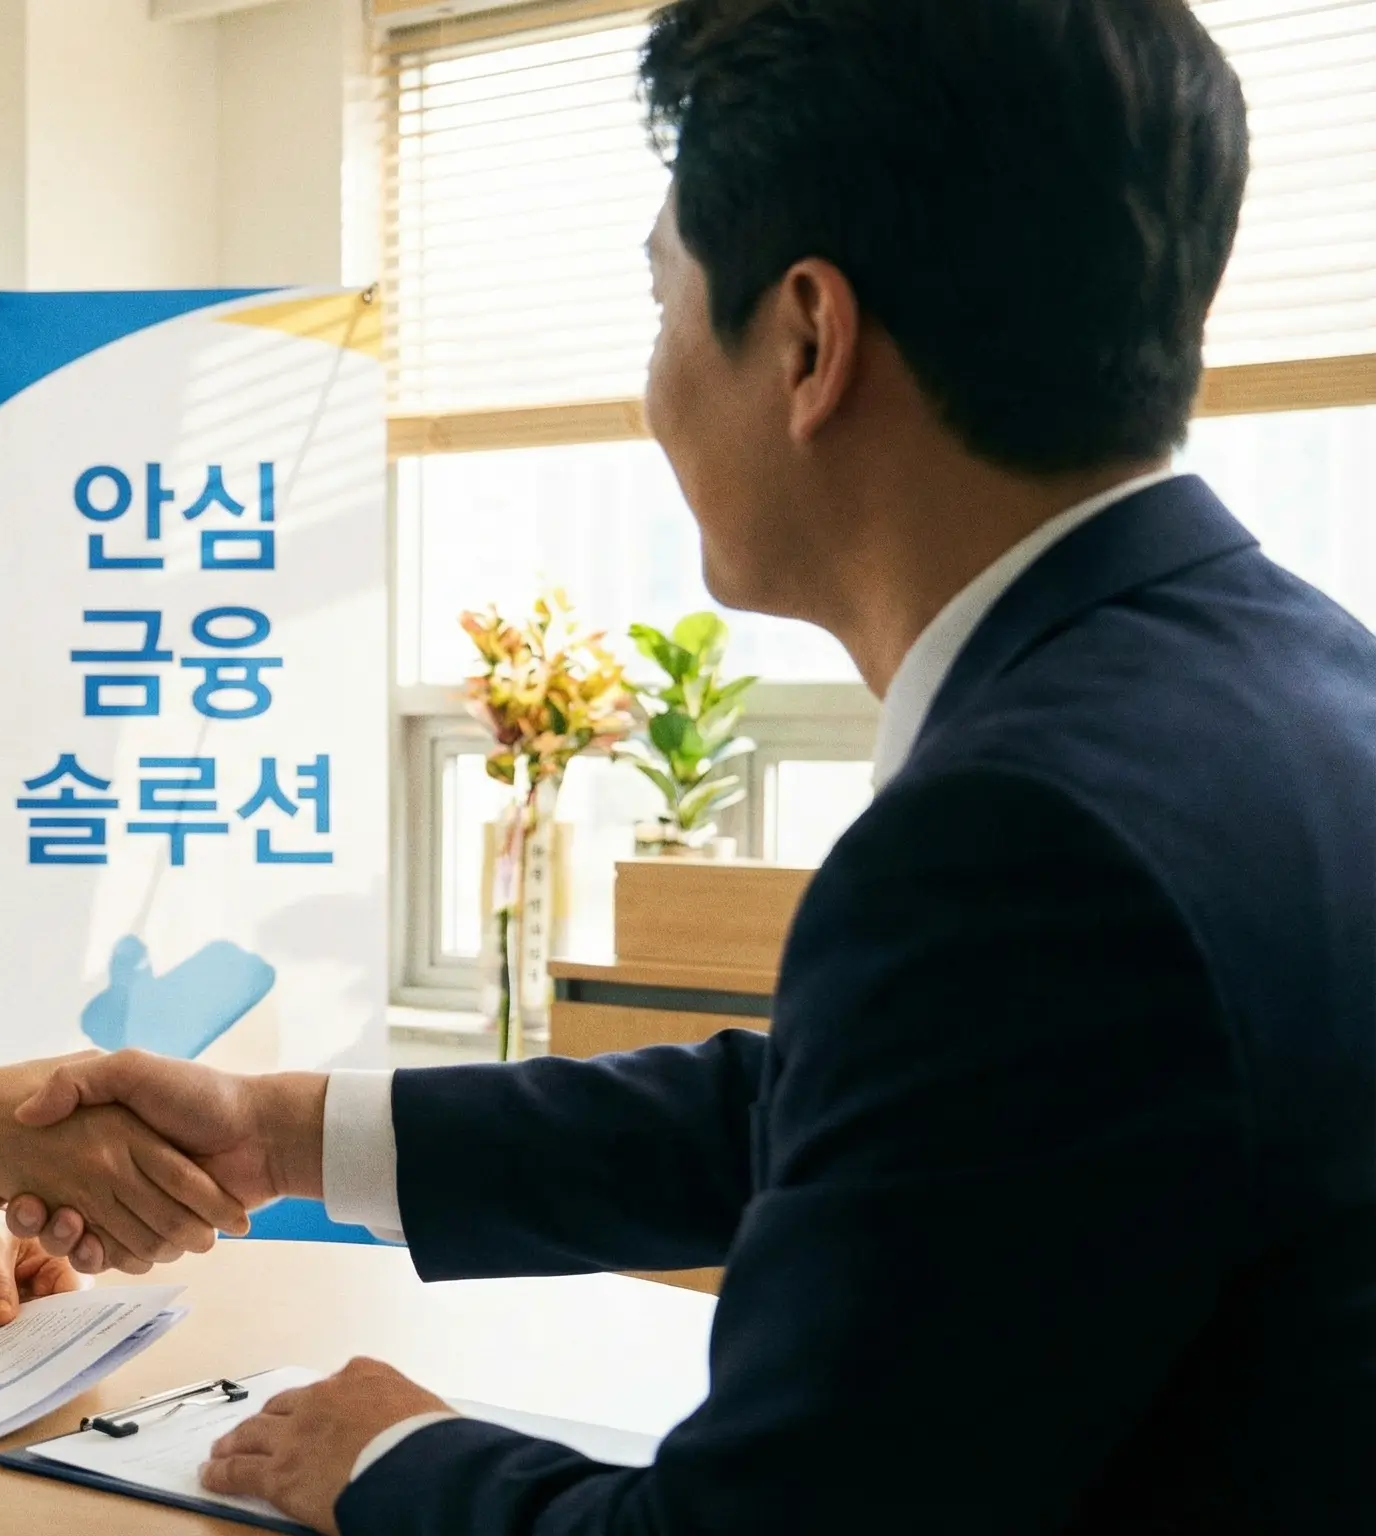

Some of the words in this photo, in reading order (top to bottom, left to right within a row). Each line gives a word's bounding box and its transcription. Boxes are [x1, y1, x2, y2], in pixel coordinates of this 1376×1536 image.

[73, 461, 277, 571] 안심
[70, 606, 284, 720] 금융
[16, 753, 334, 867] 솔루션
